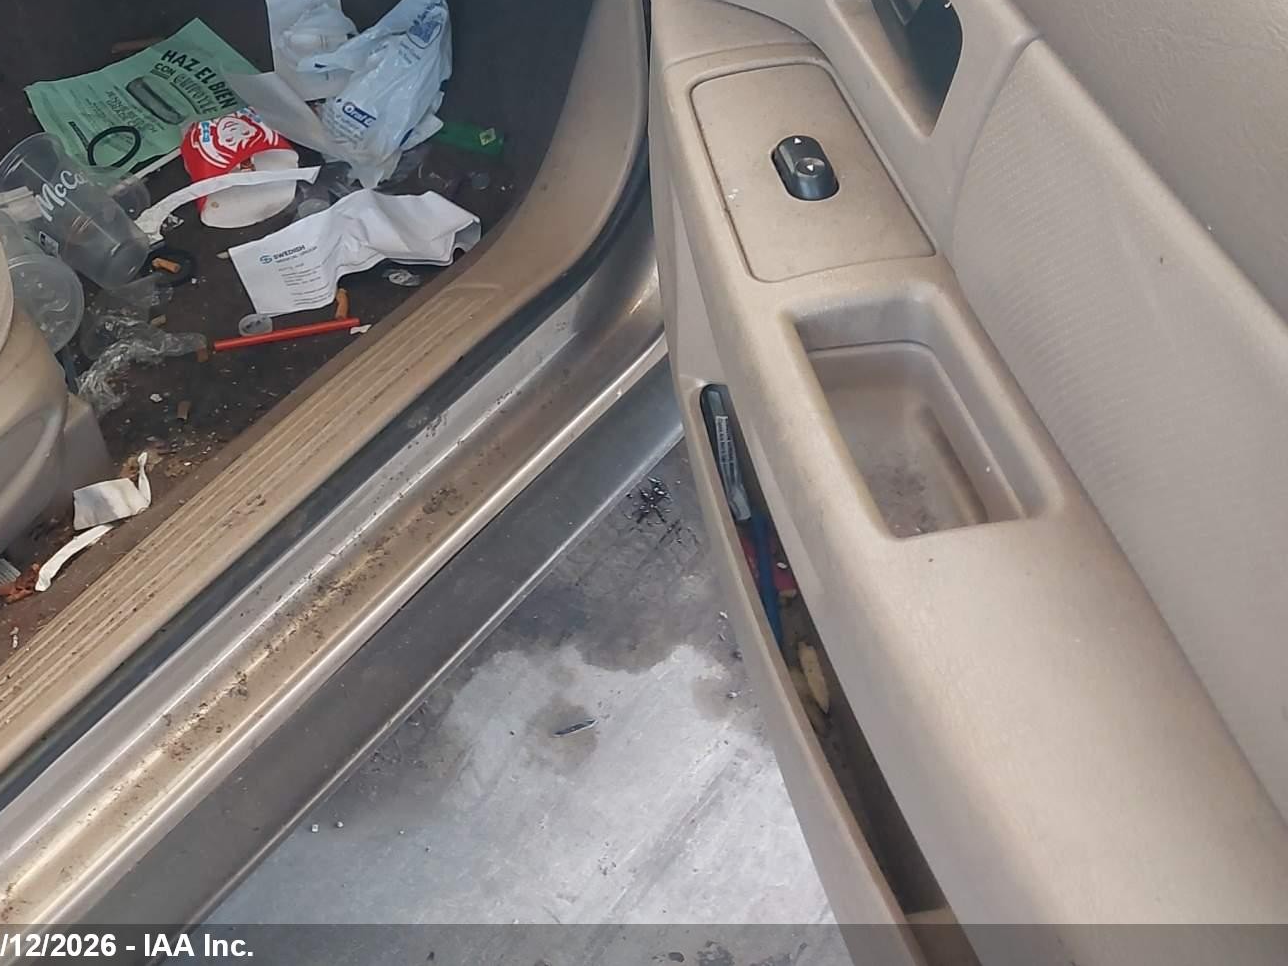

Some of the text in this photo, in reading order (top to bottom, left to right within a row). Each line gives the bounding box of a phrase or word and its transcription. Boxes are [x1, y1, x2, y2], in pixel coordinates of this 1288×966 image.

[154, 62, 175, 77] CON
[161, 49, 238, 109] HAZ EL BIEN
[34, 169, 89, 222] McCa
[273, 244, 306, 260] SWEDISH
